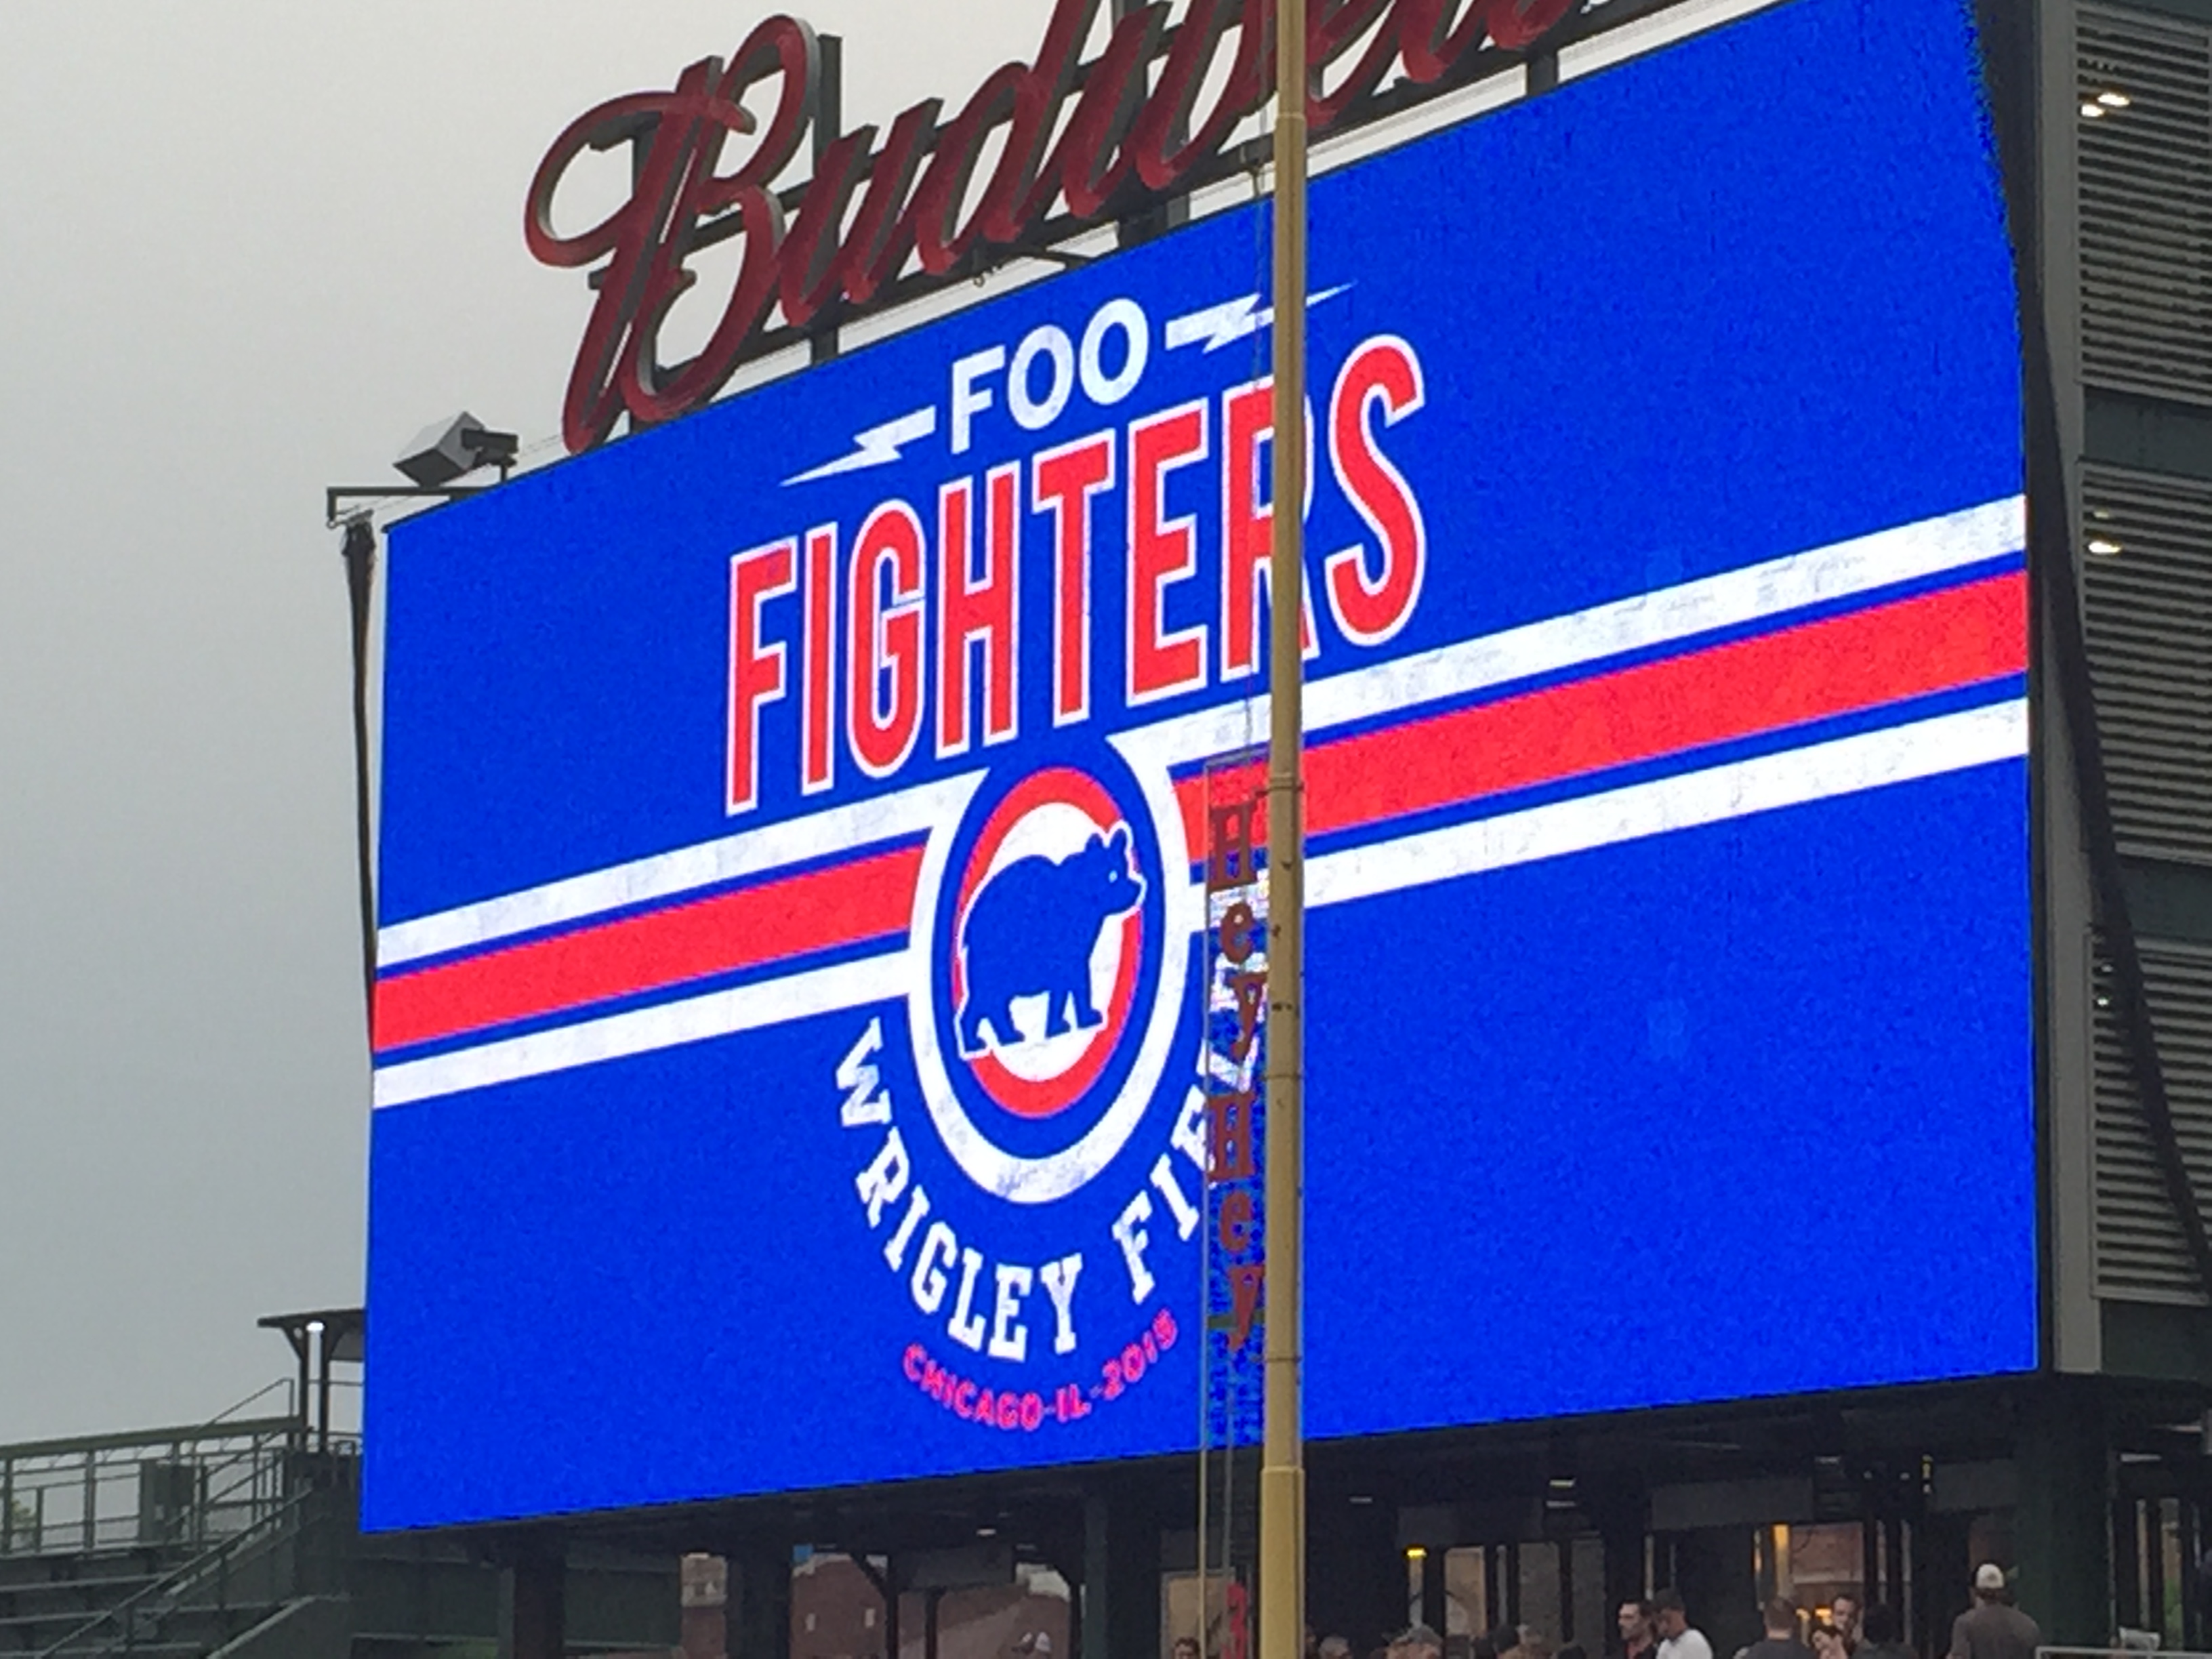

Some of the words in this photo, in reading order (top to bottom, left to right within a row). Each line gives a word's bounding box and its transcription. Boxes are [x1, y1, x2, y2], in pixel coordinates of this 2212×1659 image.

[951, 298, 1149, 453] FOO
[726, 335, 1427, 816] FIGHTERS
[1207, 796, 1267, 1065] Hey
[836, 1017, 1083, 1362] WRIGLEY
[1207, 1090, 1265, 1352] Hey
